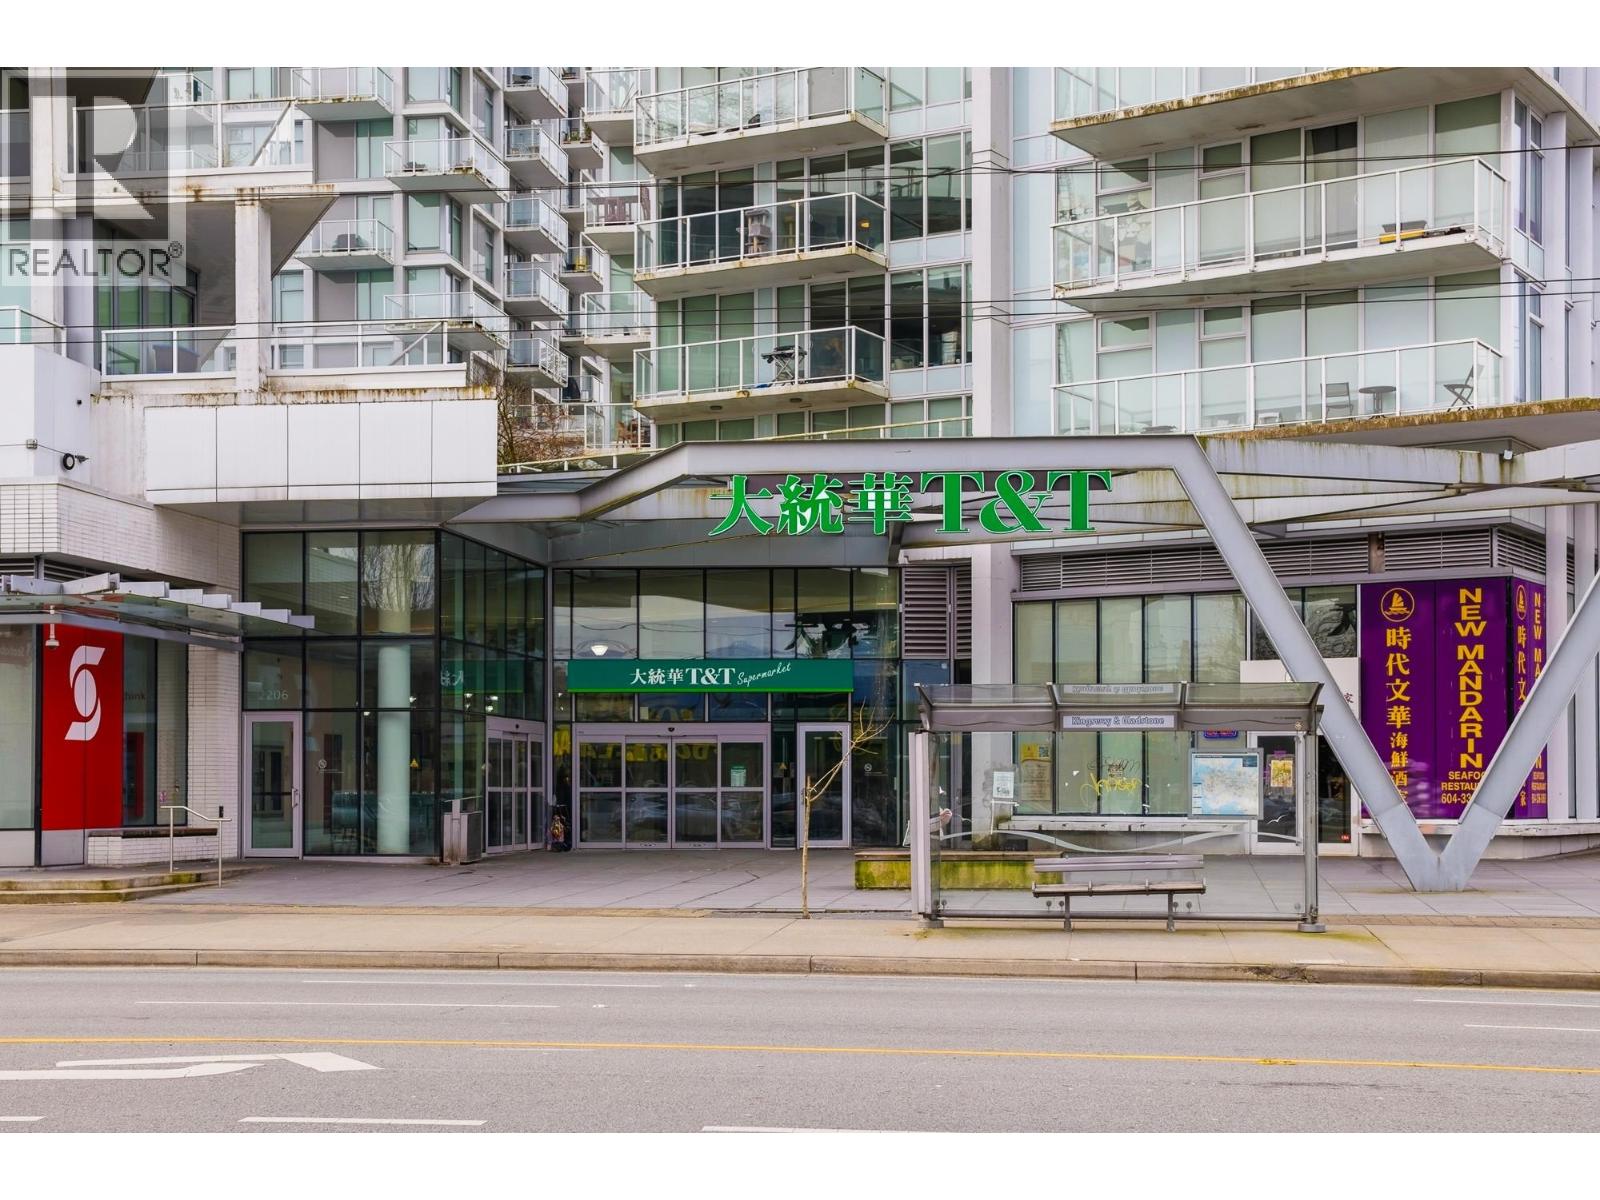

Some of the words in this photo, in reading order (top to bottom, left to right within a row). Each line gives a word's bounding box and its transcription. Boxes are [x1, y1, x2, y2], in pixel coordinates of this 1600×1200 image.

[920, 470, 1112, 533] T&T
[1455, 588, 1487, 637] NEW
[1533, 592, 1542, 640] NEW
[685, 667, 736, 685] T&T
[737, 661, 792, 687] Supermarket
[1113, 716, 1121, 725] &
[1457, 644, 1485, 769] MANDARIN
[1441, 782, 1479, 791] RESTAU
[1448, 771, 1484, 780] SEAFO
